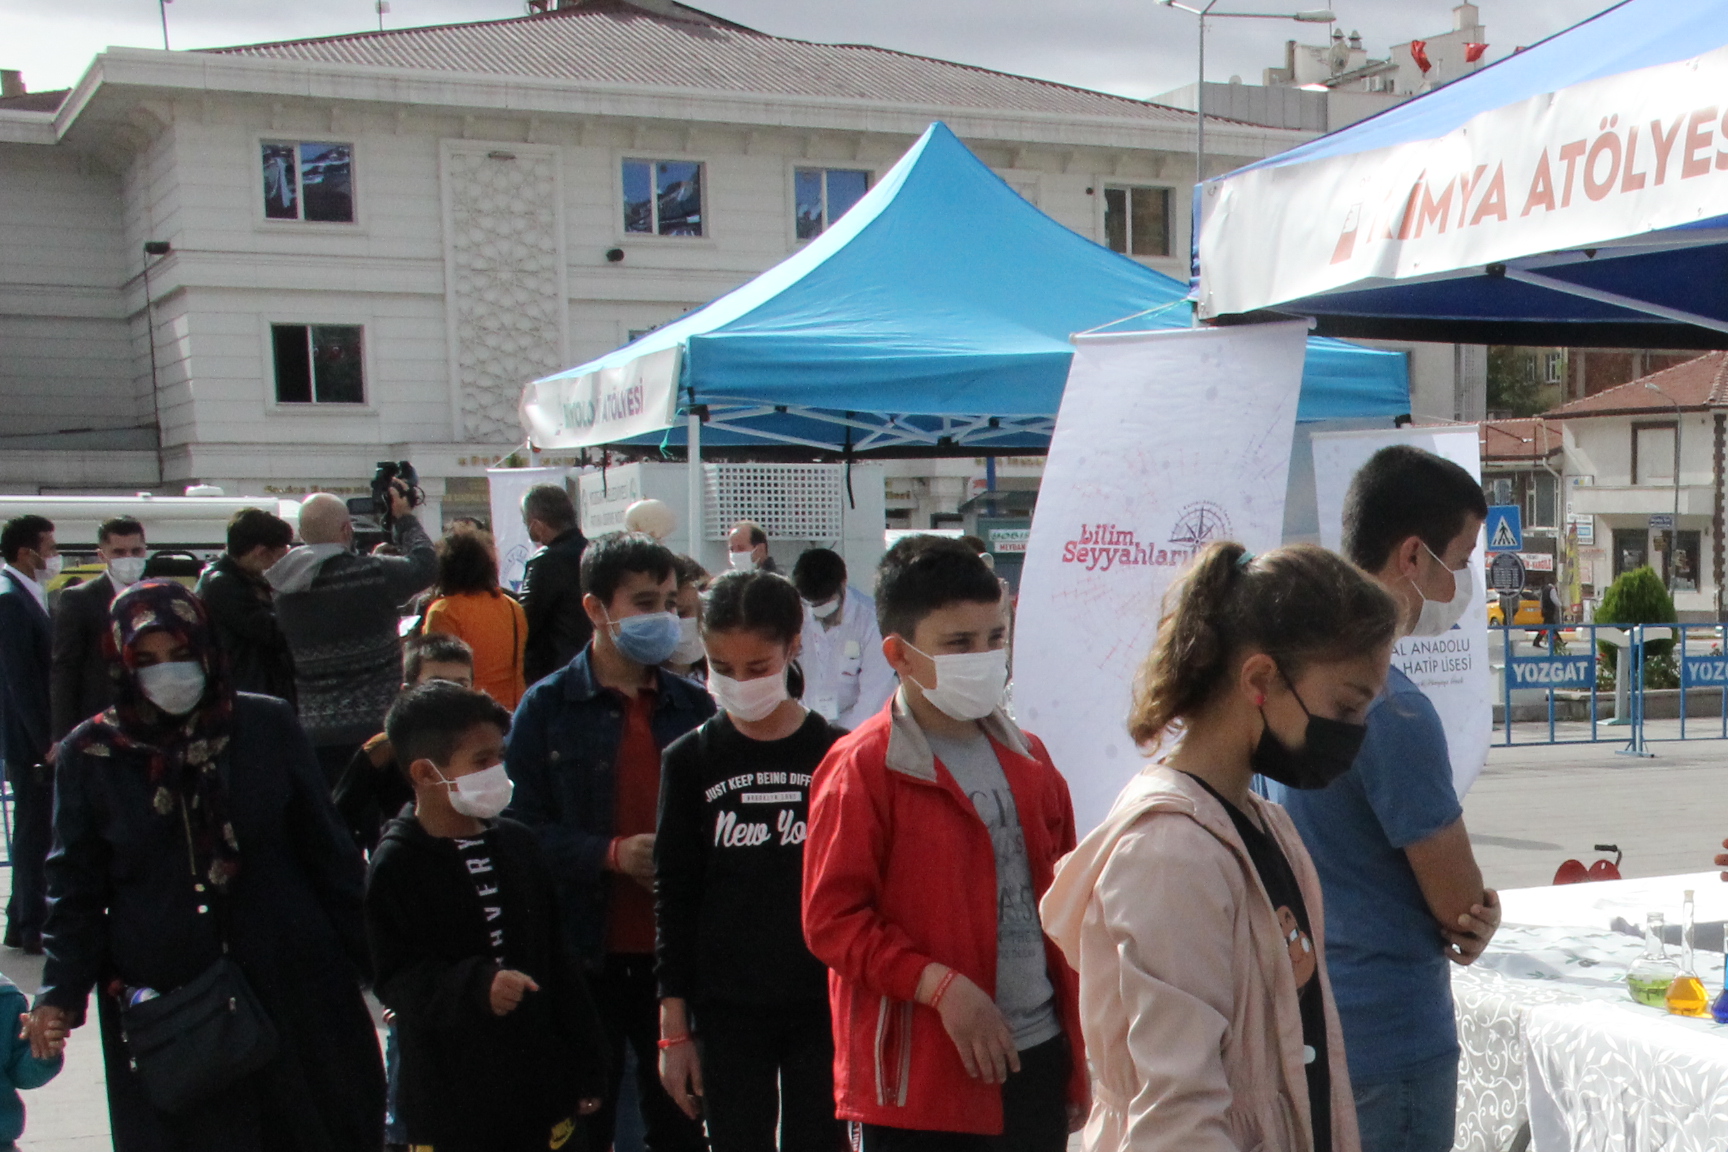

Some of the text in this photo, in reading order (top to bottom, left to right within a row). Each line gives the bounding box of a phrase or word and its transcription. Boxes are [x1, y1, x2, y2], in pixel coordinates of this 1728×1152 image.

[1078, 524, 1135, 546] bilim
[1411, 638, 1470, 655] ANADOLU
[1403, 654, 1472, 675] HATİP LİSESİ
[1512, 661, 1589, 683] YOZGAT
[705, 781, 727, 802] JUST
[728, 774, 754, 791] KEEP
[756, 772, 787, 785] BEING
[714, 810, 771, 848] New
